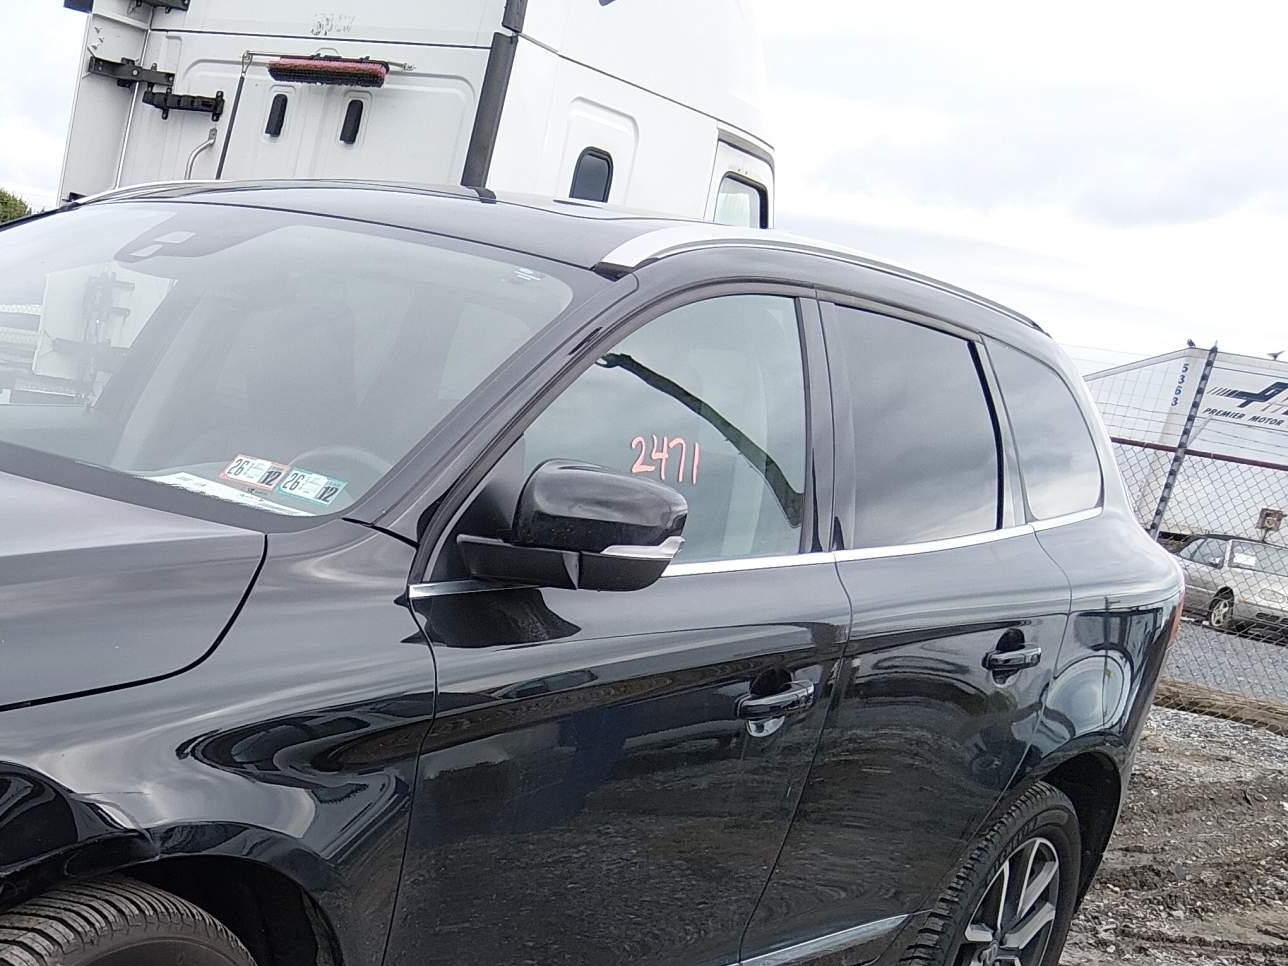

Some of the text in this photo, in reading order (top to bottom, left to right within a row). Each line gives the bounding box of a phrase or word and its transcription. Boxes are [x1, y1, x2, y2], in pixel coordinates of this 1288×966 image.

[1170, 363, 1190, 407] 5363
[1202, 407, 1285, 426] PREMIER MOTOR
[226, 458, 250, 476] 26
[260, 469, 283, 487] 12
[631, 434, 700, 485] 2471
[282, 473, 306, 491] 26
[316, 485, 340, 503] 12
